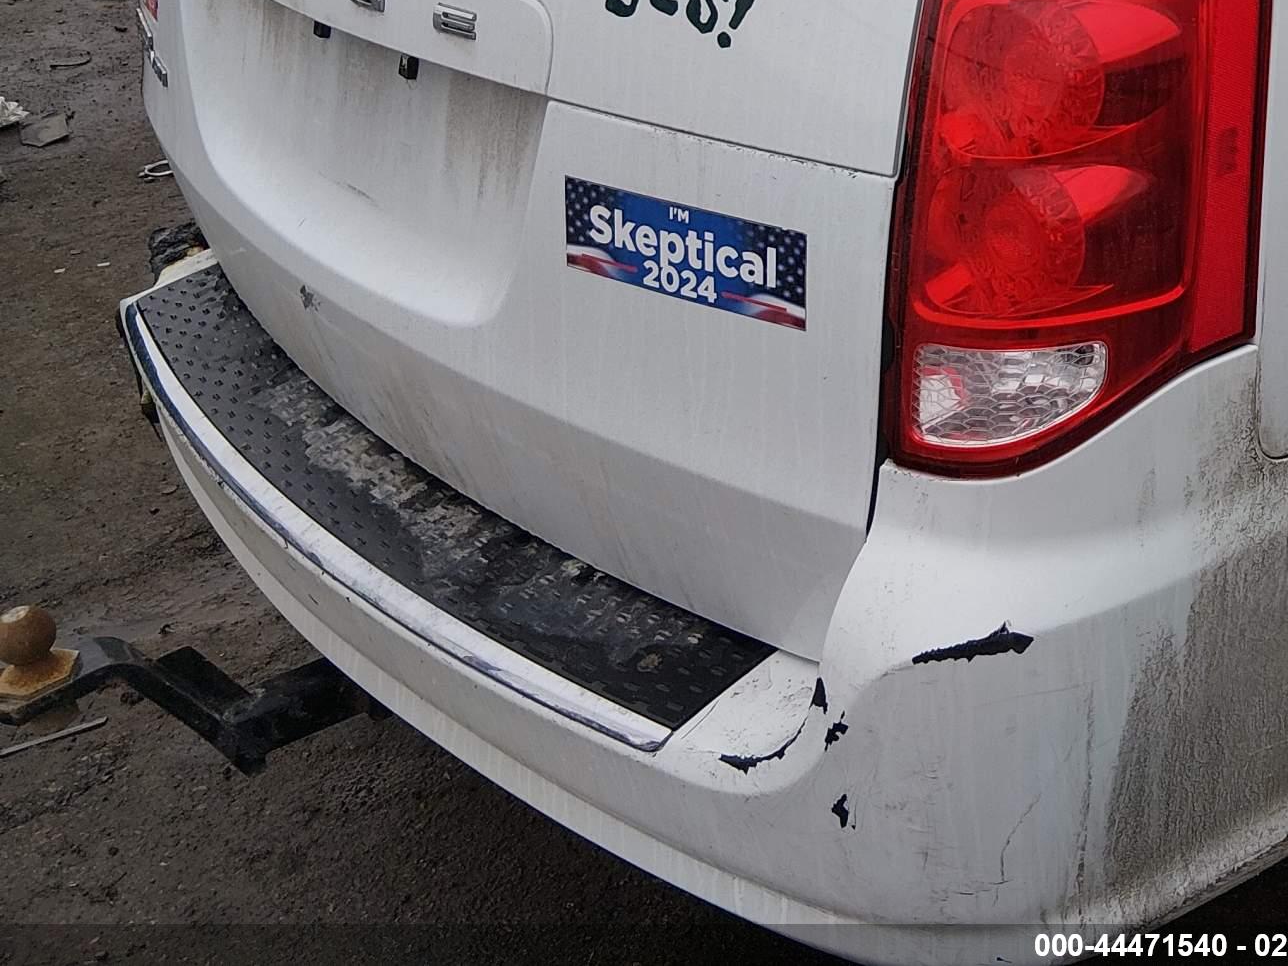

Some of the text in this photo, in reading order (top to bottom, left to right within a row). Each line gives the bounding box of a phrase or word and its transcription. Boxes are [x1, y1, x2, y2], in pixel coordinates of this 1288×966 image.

[669, 206, 690, 224] I'M
[589, 204, 777, 289] Skeptical
[643, 259, 717, 304] 2024
